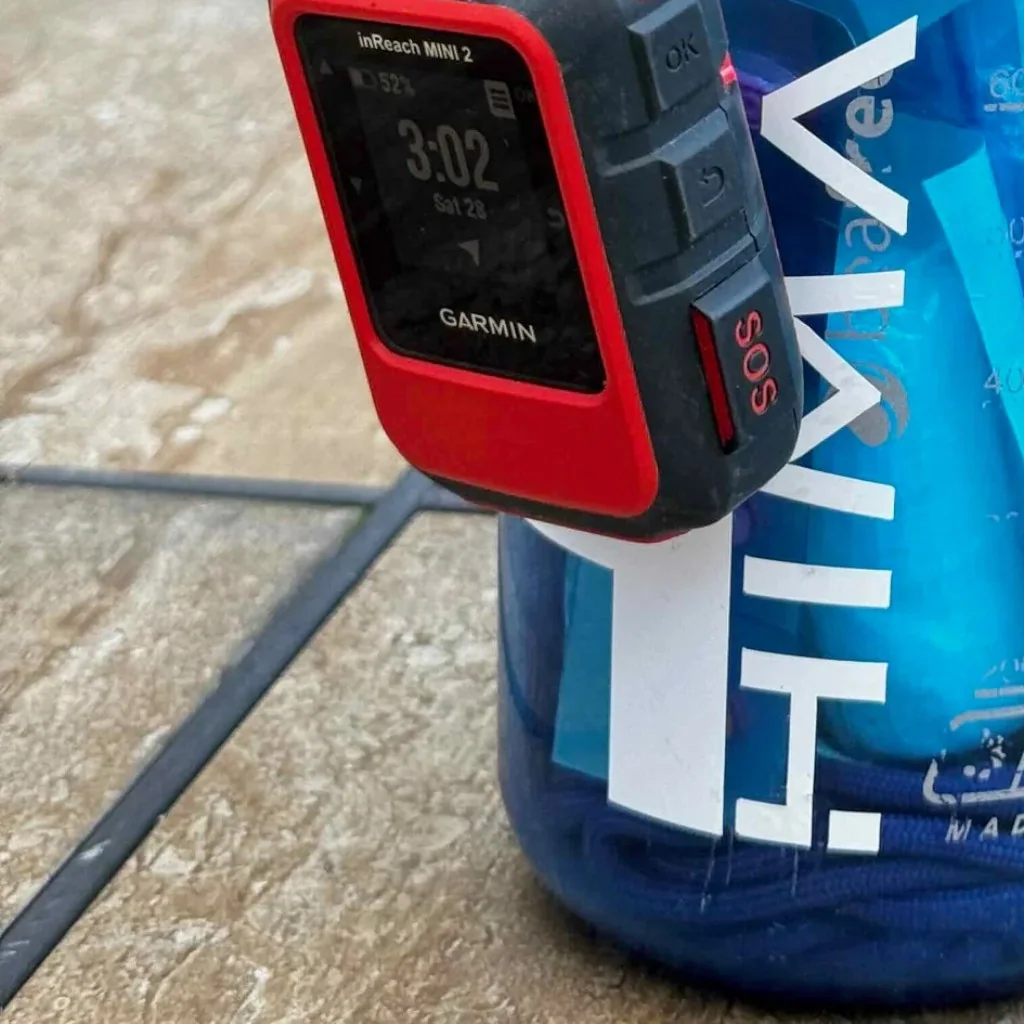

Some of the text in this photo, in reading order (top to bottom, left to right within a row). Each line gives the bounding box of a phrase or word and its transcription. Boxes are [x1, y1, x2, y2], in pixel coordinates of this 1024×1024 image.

[357, 31, 474, 64] inReach MINI 2
[664, 32, 700, 73] OK
[397, 118, 499, 193] 3:02
[433, 192, 488, 220] Sat 28
[438, 307, 537, 344] GARMIN
[734, 309, 778, 416] SOS
